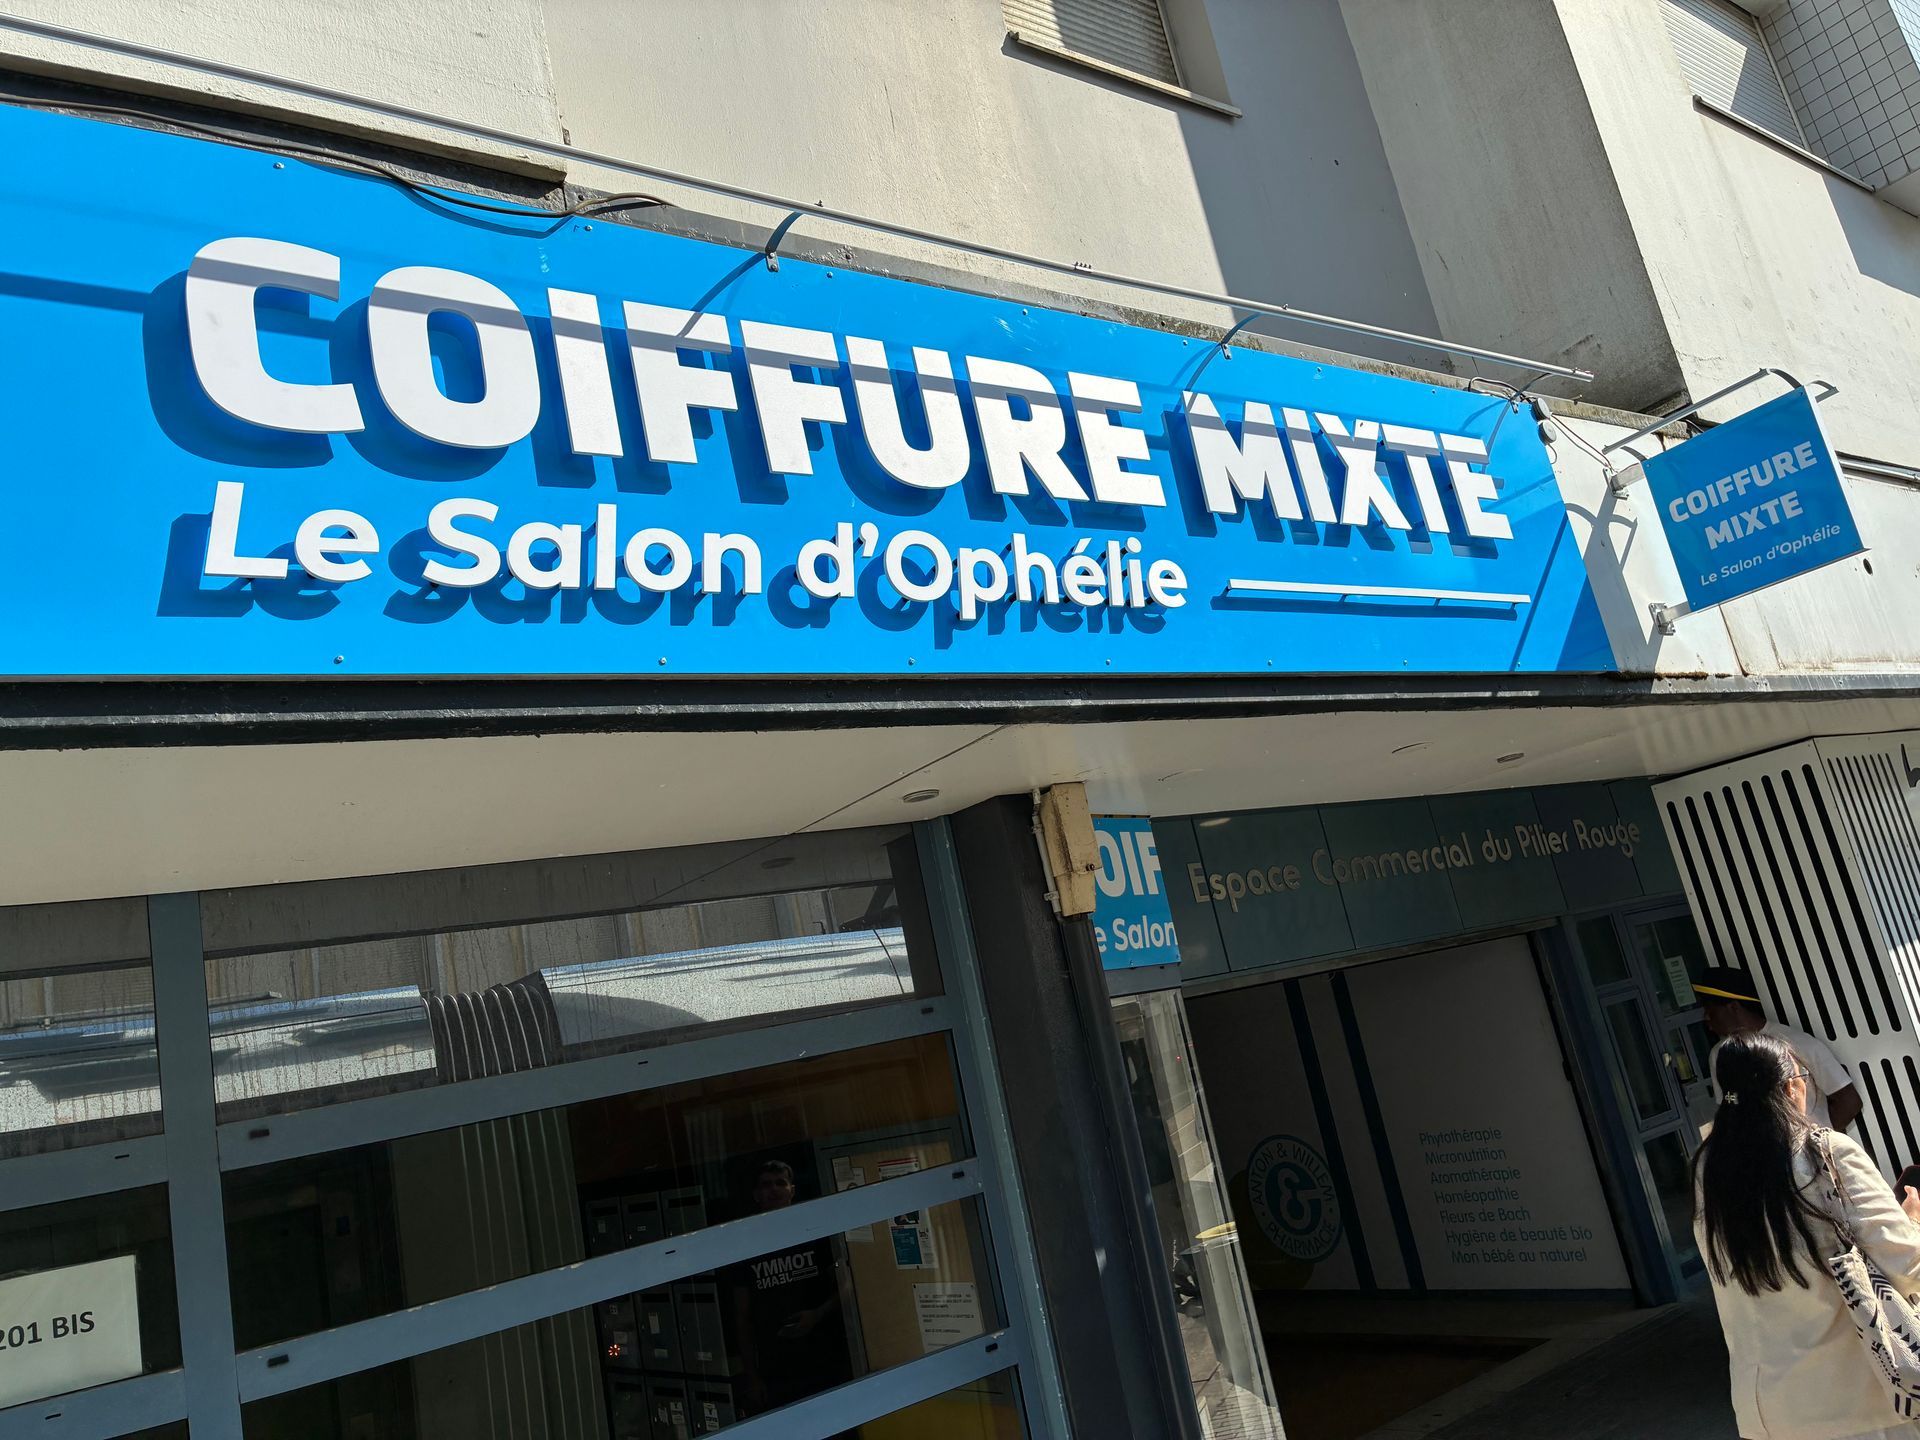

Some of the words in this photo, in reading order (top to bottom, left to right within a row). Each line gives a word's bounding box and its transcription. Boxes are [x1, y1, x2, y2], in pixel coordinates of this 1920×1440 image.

[185, 237, 1166, 507] COIFFURE
[1182, 391, 1514, 540] MIXTE
[1668, 441, 1817, 523] COIFFURE
[1704, 491, 1803, 550] MIXTE
[204, 481, 380, 582] Le
[422, 498, 762, 594] Salon
[1700, 571, 1717, 586] Le
[1720, 555, 1763, 578] Salon
[1187, 862, 1300, 912] Espace
[1311, 832, 1474, 886] Commercial
[1481, 828, 1512, 863] du
[1515, 823, 1569, 858] Pilier
[1572, 818, 1640, 858] Rouge
[1113, 915, 1178, 951] Salon
[1418, 1128, 1502, 1147] Phytothérapie
[1424, 1148, 1506, 1165] Micronutrition
[1250, 1147, 1274, 1206] ANTON
[1293, 1144, 1334, 1200] WILLEM
[1431, 1166, 1521, 1184] Aromathérapie
[1434, 1187, 1519, 1205] Homéopathie
[1440, 1209, 1475, 1224] Fleurs
[1478, 1208, 1495, 1222] de
[1498, 1206, 1531, 1222] Bach
[1268, 1219, 1336, 1255] PHARMACIE
[1445, 1229, 1496, 1246] Hygiène
[1500, 1228, 1517, 1242] de
[1519, 1226, 1567, 1241] beauté
[1570, 1225, 1593, 1241] bio
[1451, 1250, 1480, 1264] Mon
[1483, 1249, 1515, 1263] bébé
[1519, 1251, 1536, 1262] au
[1540, 1248, 1587, 1262] naturel
[52, 1311, 95, 1338] BIS
